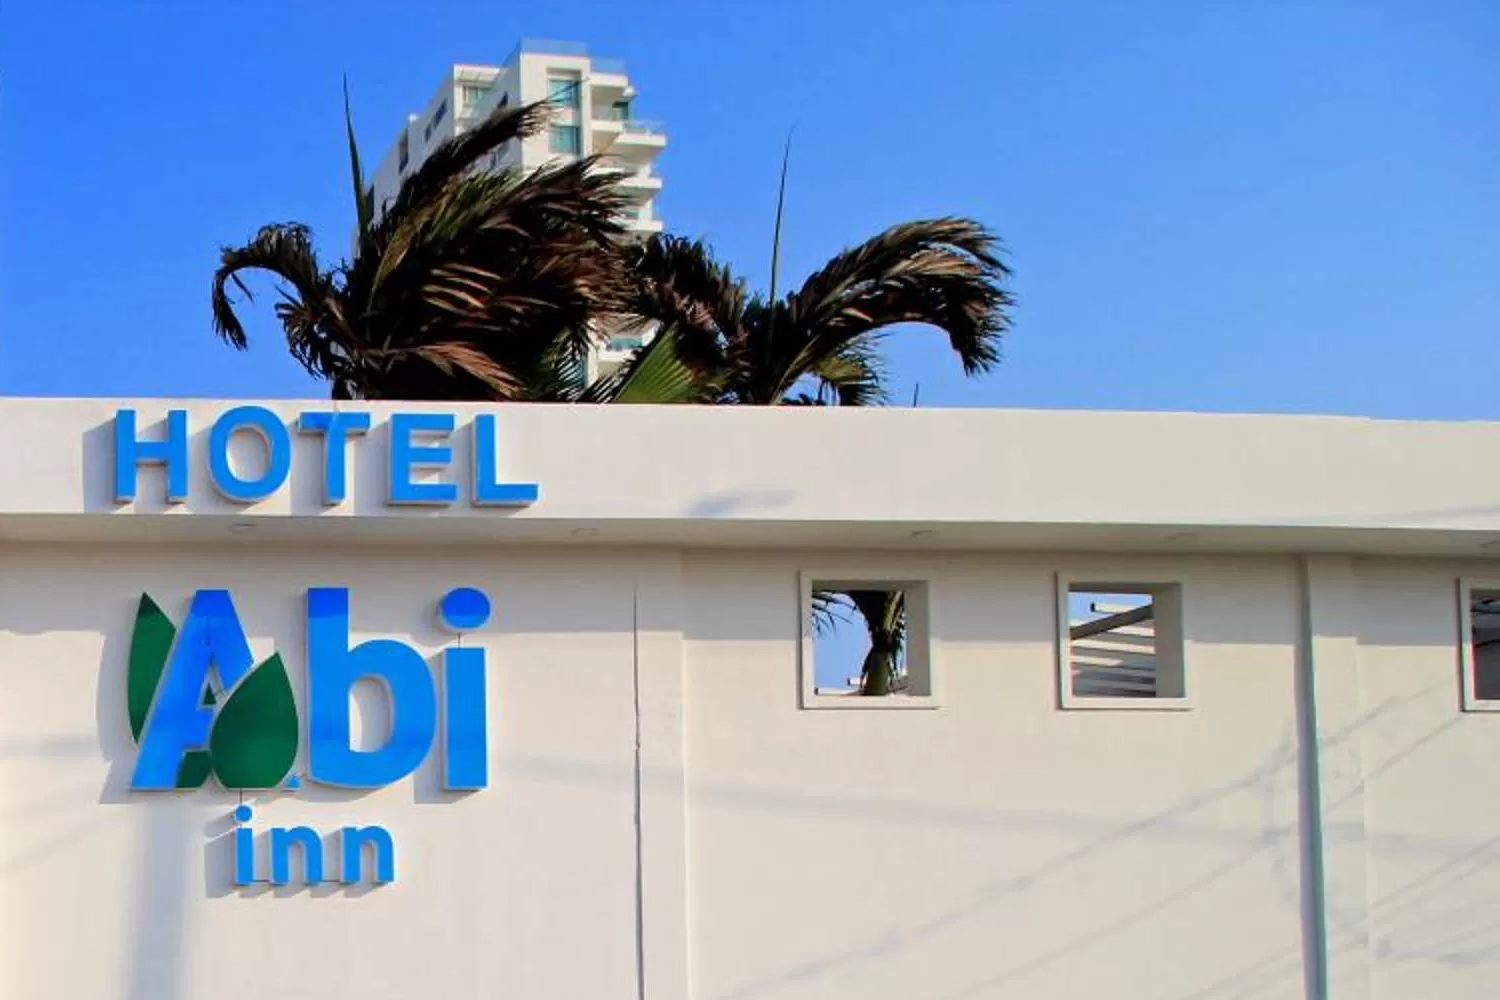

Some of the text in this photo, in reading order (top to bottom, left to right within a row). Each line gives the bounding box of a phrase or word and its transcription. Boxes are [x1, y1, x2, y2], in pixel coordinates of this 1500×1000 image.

[112, 404, 539, 504] HOTEL
[130, 586, 493, 790] Abi
[232, 804, 395, 886] inn
